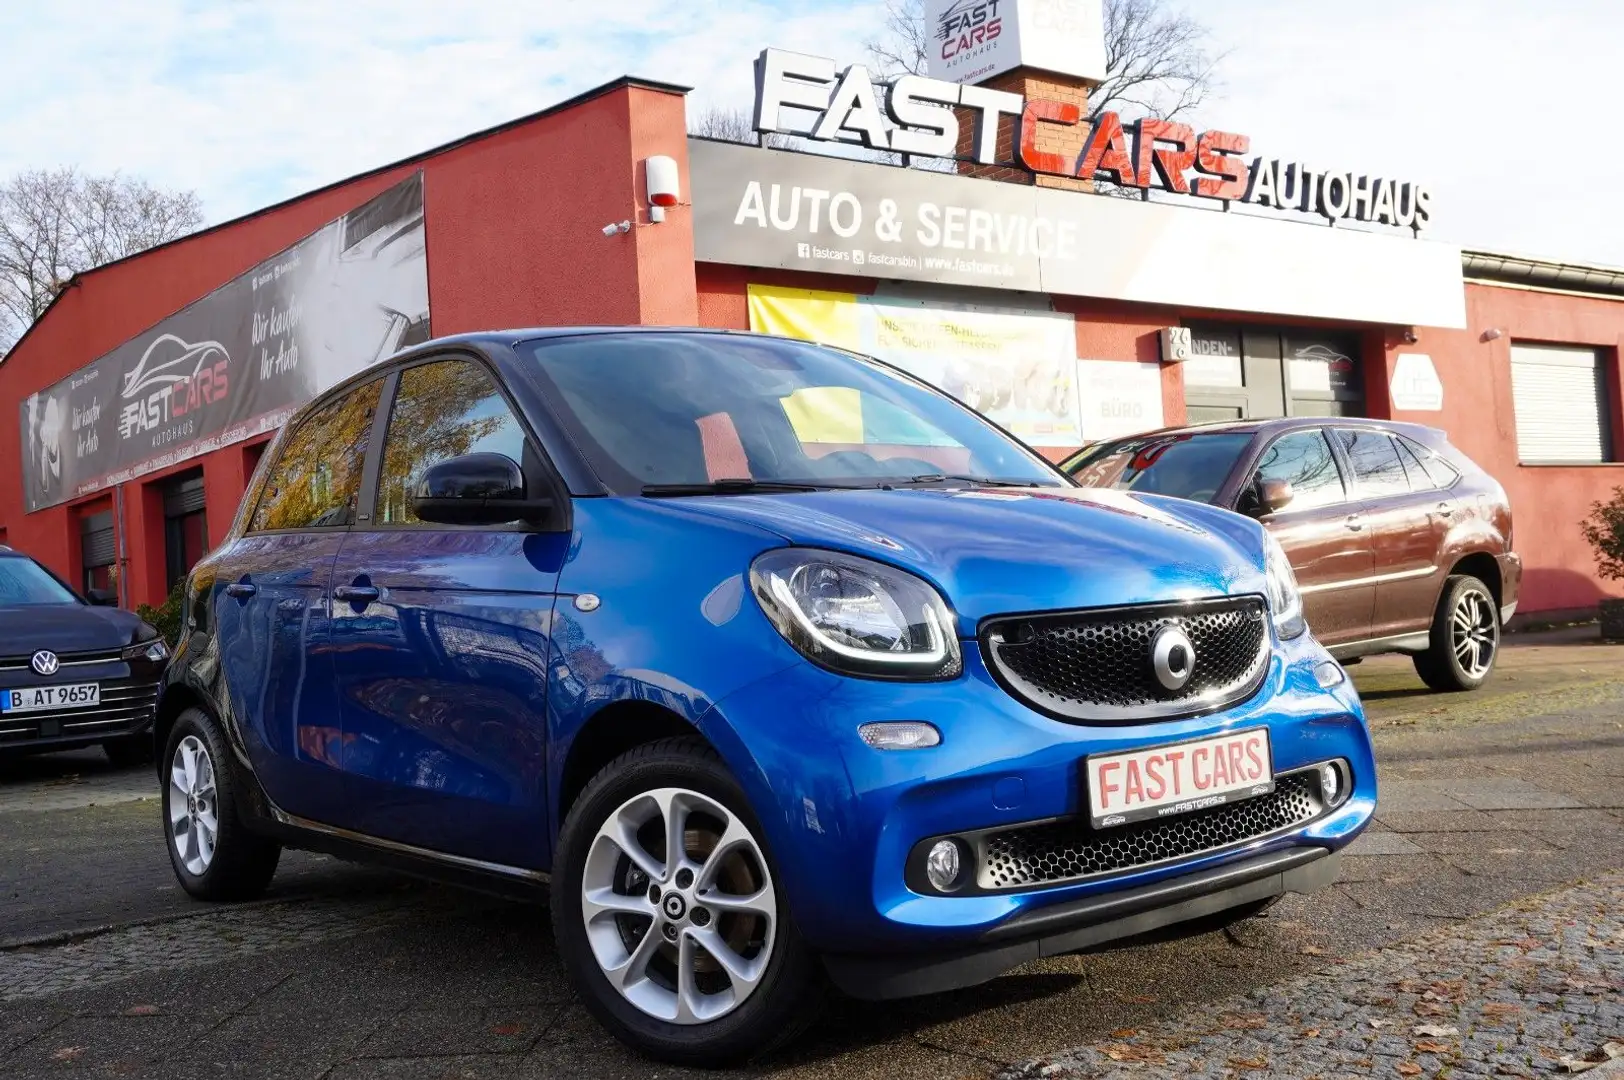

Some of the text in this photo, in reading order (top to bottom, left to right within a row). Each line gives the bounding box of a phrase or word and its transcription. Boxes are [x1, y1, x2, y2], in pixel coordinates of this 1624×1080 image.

[934, 0, 1000, 41] FAST
[941, 16, 1002, 60] CARS
[946, 41, 998, 69] AUTOHAUS
[1247, 155, 1433, 231] AUTOHAUS
[734, 180, 1079, 261] AUTO & SERVICE
[812, 246, 850, 261] fastcars
[252, 311, 269, 347] Wir
[260, 336, 298, 381] Ihr Auto
[1190, 339, 1233, 356] NDEN-
[1100, 396, 1143, 418] BÜRO
[151, 420, 194, 448] AUTOHAUS
[11, 685, 98, 707] B AT 9657
[1098, 737, 1263, 809] FAST CARS
